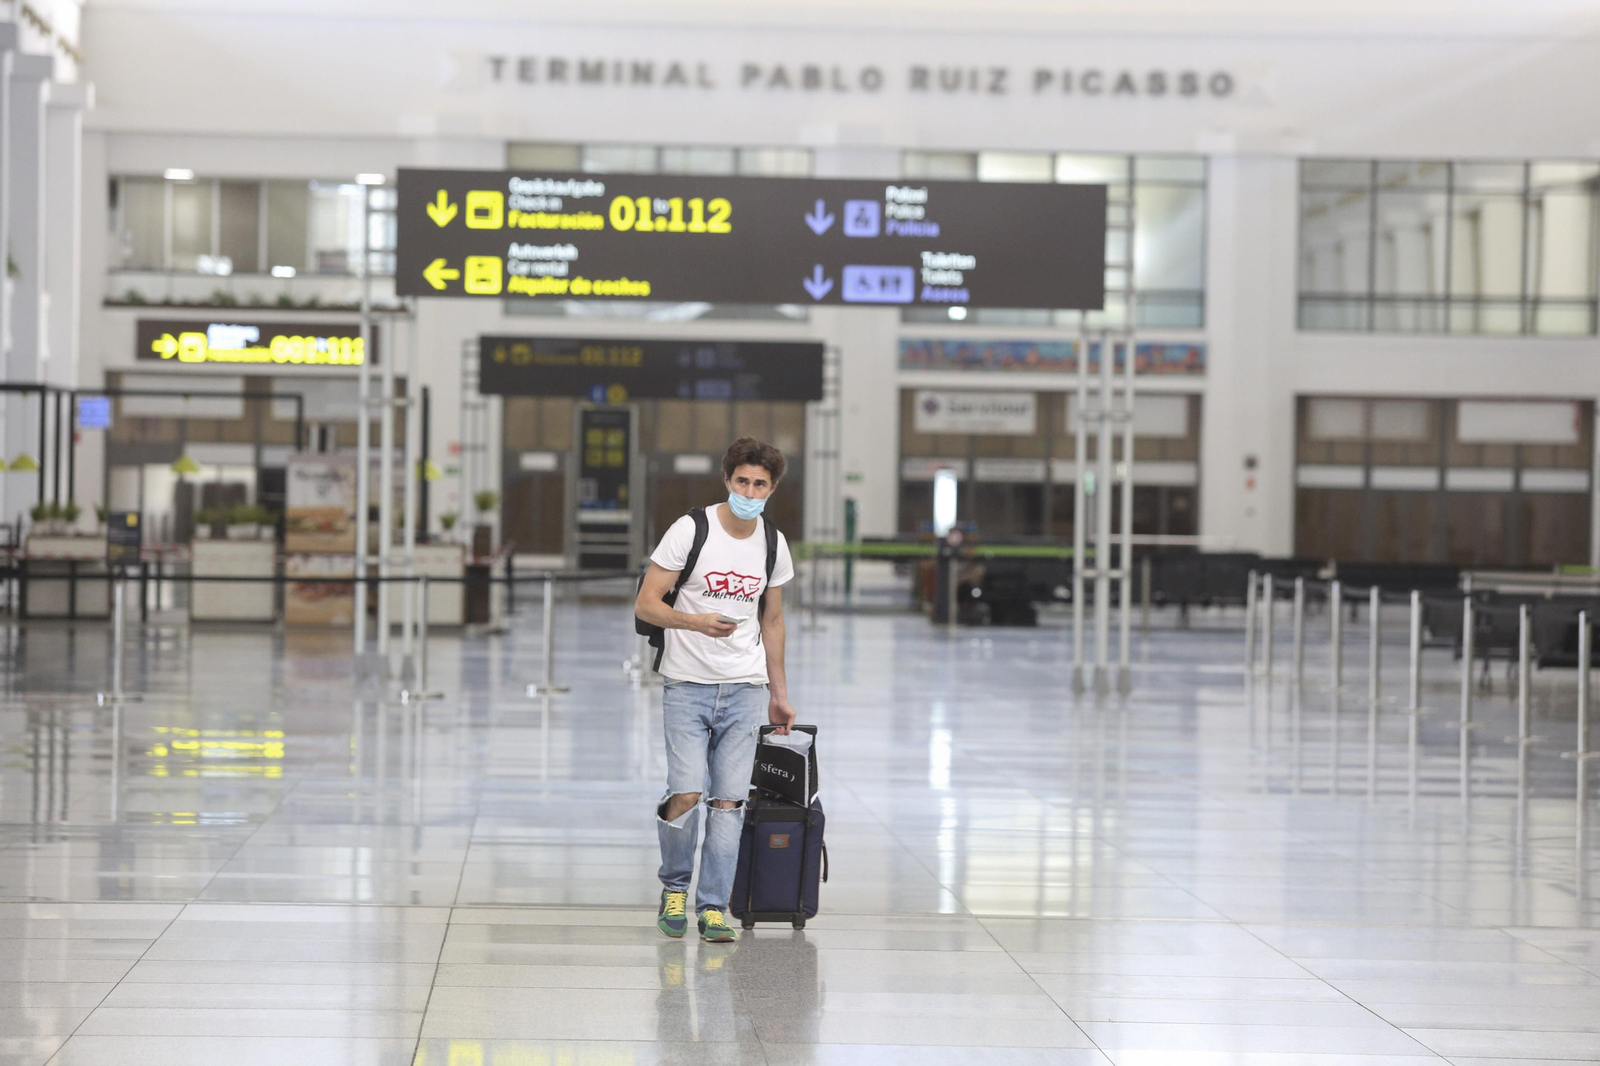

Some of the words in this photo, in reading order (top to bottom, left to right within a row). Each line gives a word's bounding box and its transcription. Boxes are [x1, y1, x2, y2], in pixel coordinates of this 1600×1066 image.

[488, 55, 716, 89] TERMINAL
[741, 62, 885, 93] PABLO
[909, 64, 1008, 96] RUIZ
[1031, 67, 1236, 99] PICASSO
[508, 210, 604, 230] Facturación
[885, 203, 925, 220] Police
[508, 275, 568, 296] Alquiler
[569, 276, 591, 294] de
[592, 278, 650, 296] coches
[921, 284, 970, 302] Aseos
